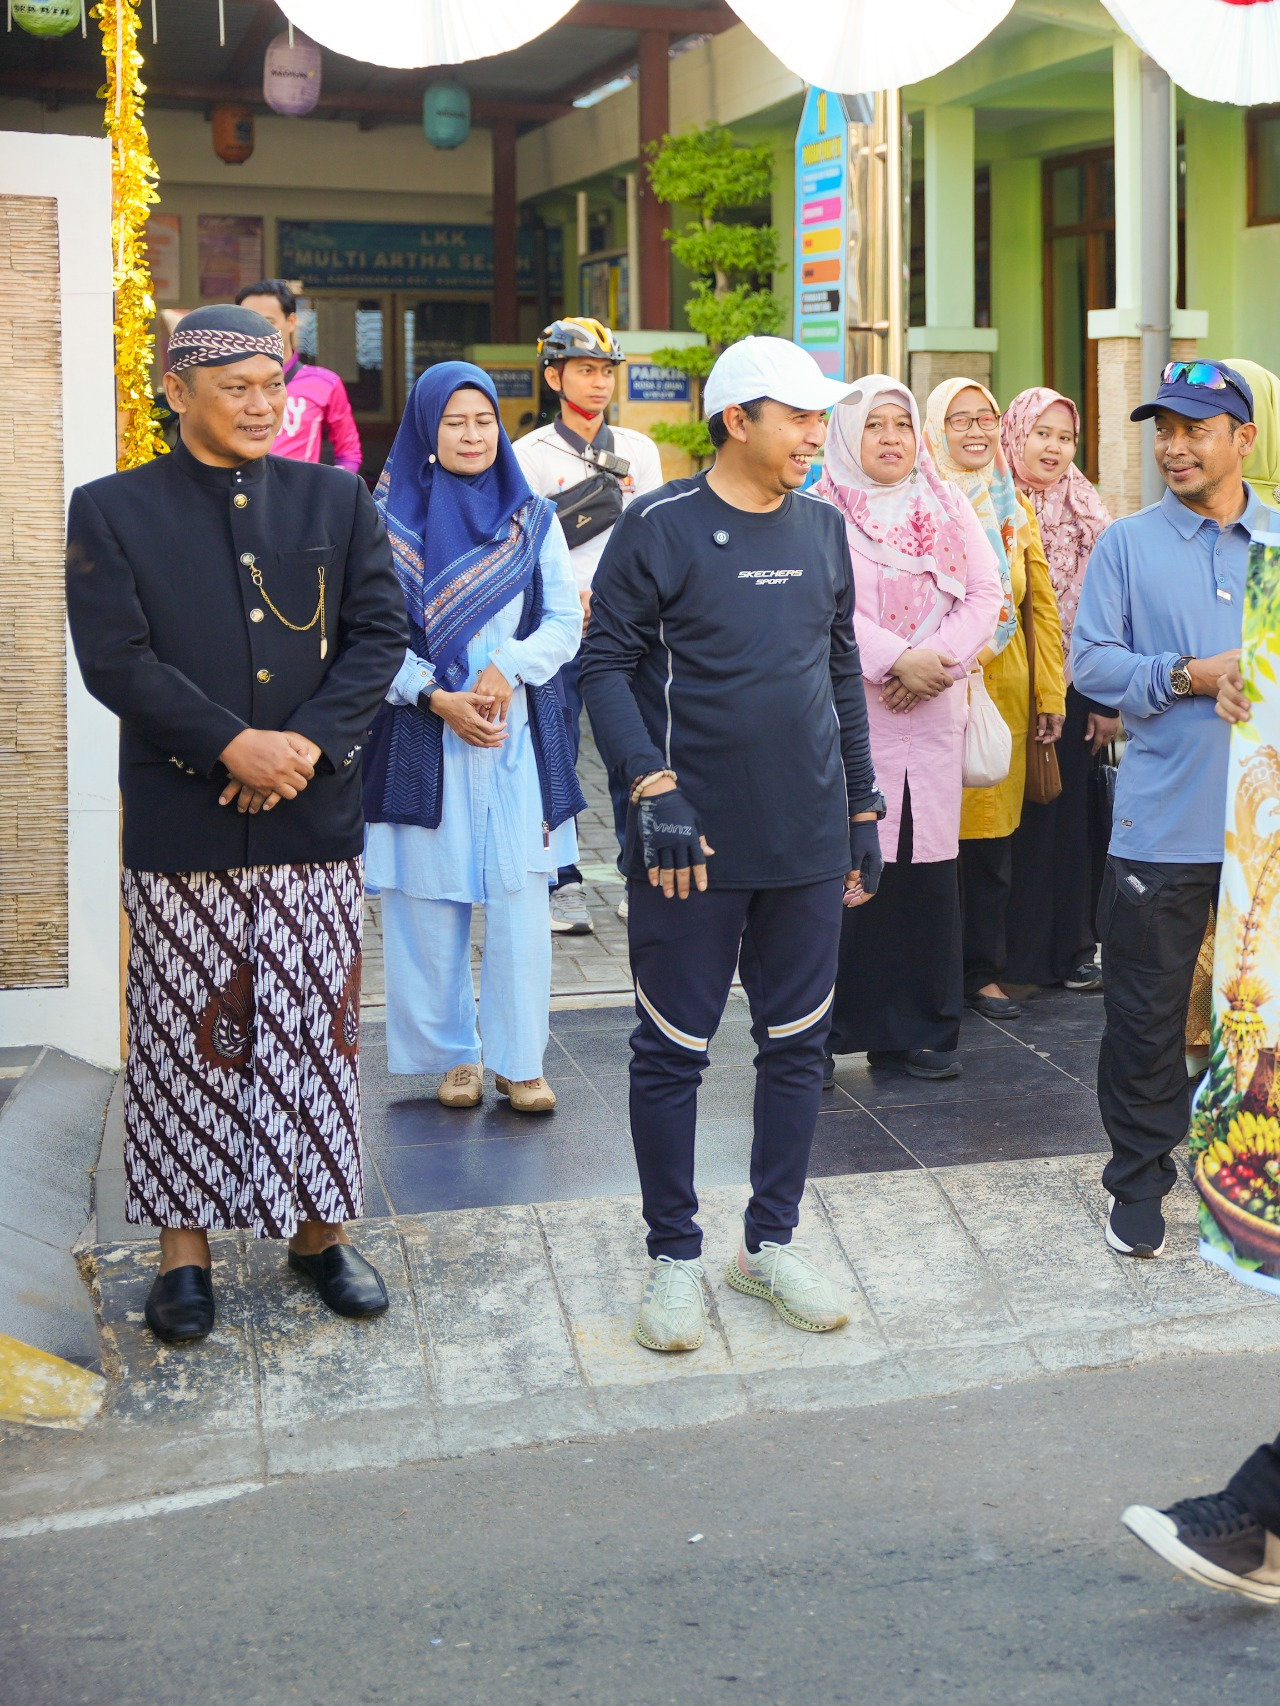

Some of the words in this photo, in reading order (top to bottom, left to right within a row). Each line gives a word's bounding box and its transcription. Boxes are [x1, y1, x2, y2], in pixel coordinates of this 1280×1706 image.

[420, 230, 466, 248] LKK
[374, 250, 452, 271] ARTHA
[737, 569, 804, 579] SKECHERS
[755, 578, 789, 586] SPORT
